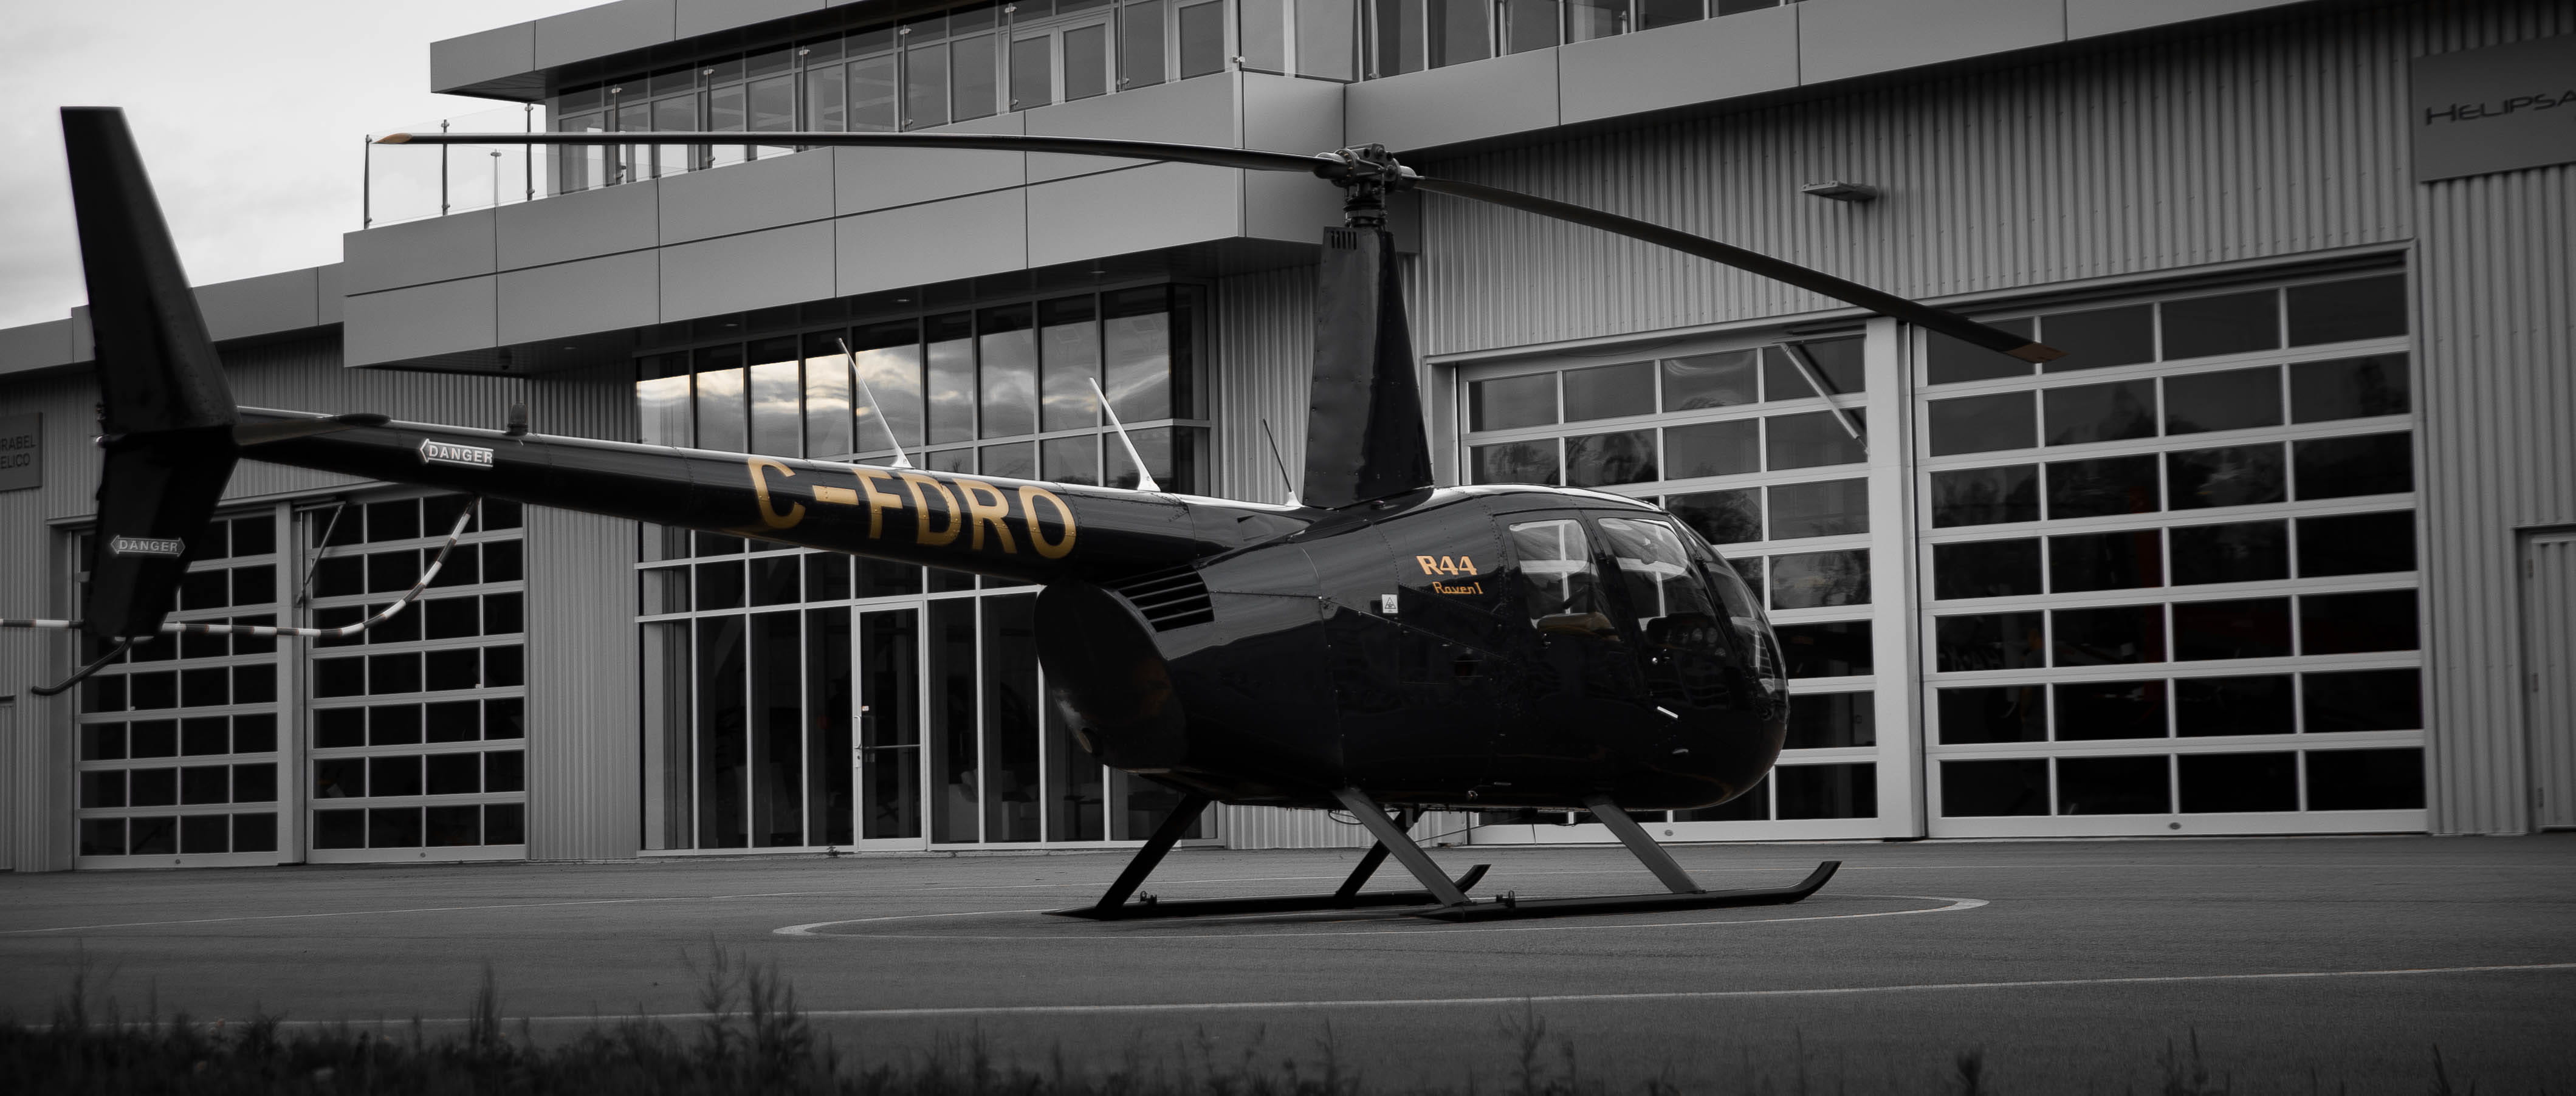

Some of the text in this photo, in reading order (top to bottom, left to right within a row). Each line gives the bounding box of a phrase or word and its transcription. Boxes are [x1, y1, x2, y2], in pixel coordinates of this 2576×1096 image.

[429, 444, 493, 464] DANGER
[747, 456, 1076, 559] C-FDRO
[119, 539, 178, 552] DANGER
[1416, 555, 1478, 575] R44
